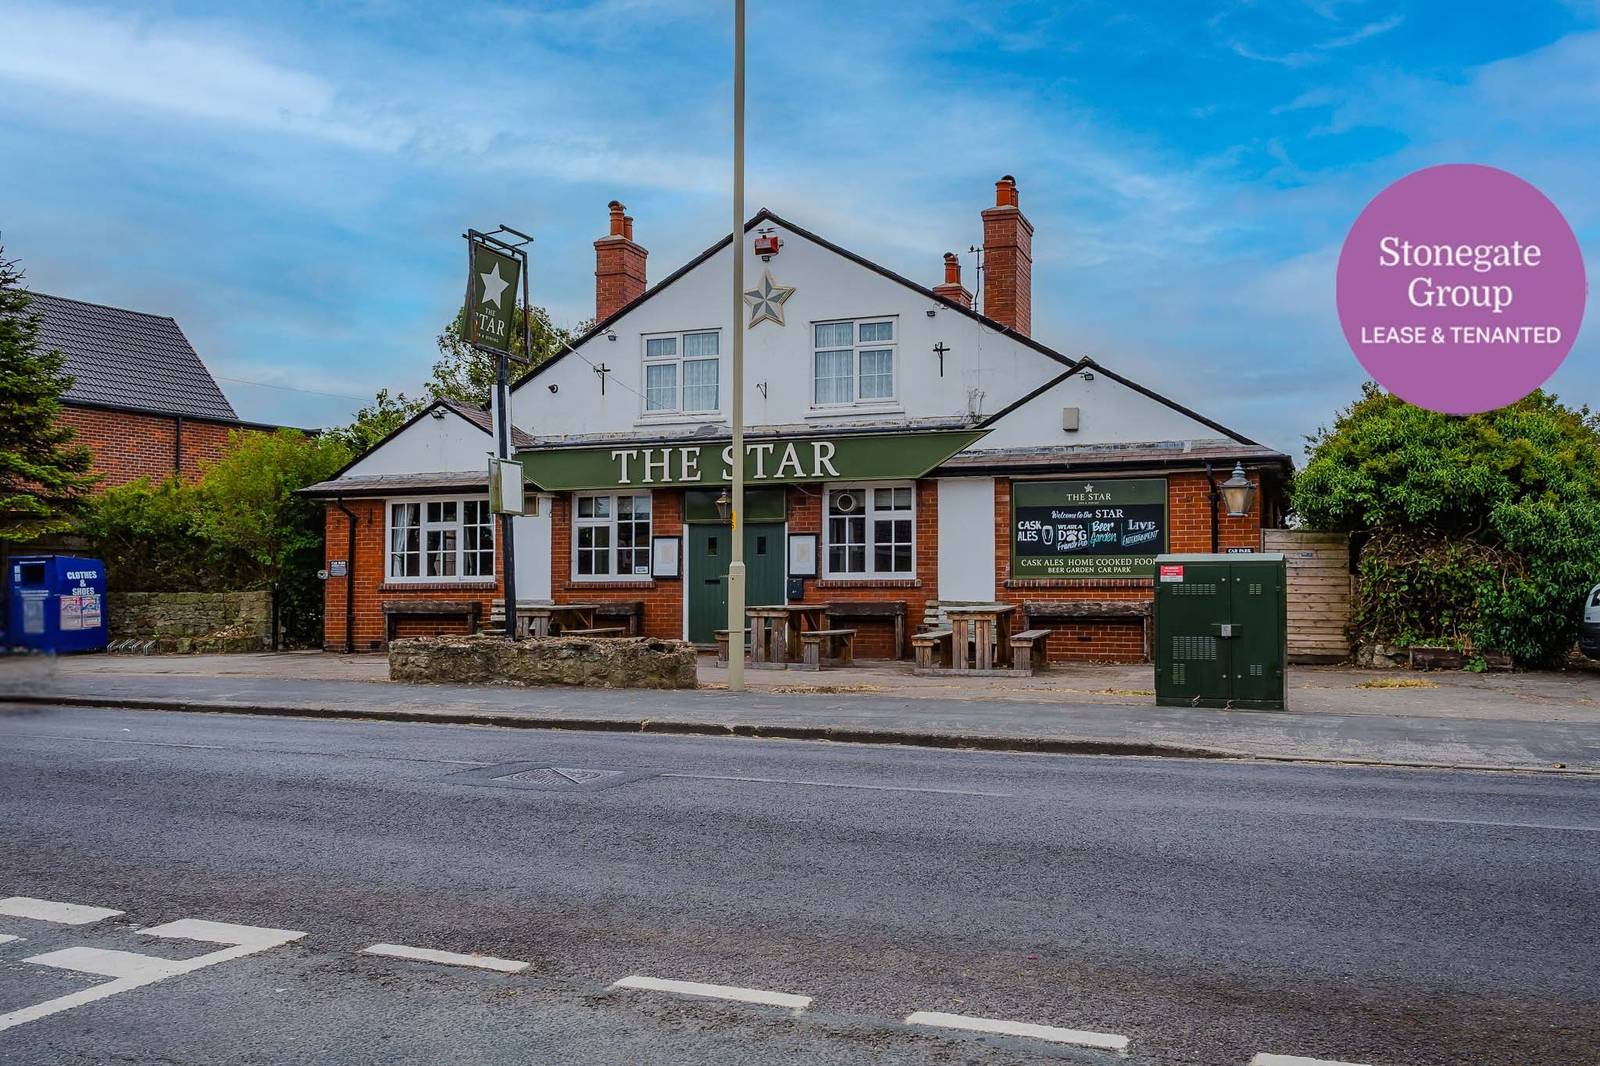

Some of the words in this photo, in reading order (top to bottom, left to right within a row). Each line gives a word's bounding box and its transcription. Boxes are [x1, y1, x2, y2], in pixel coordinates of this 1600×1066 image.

[485, 307, 496, 317] THE
[476, 312, 504, 337] TAR
[611, 447, 702, 484] THE
[1066, 493, 1086, 501] THE
[1088, 492, 1112, 501] STAR
[1095, 508, 1125, 519] STAR
[1017, 520, 1042, 530] CASK
[1092, 520, 1114, 532] Beer
[1017, 530, 1039, 542] ALES
[1021, 559, 1042, 567] CASK
[1043, 558, 1064, 566] ALES
[1068, 558, 1094, 566] HOME
[1096, 558, 1132, 566] COOKED
[66, 571, 97, 580] CLOTHES
[80, 579, 87, 587] &
[72, 587, 95, 597] SHOES
